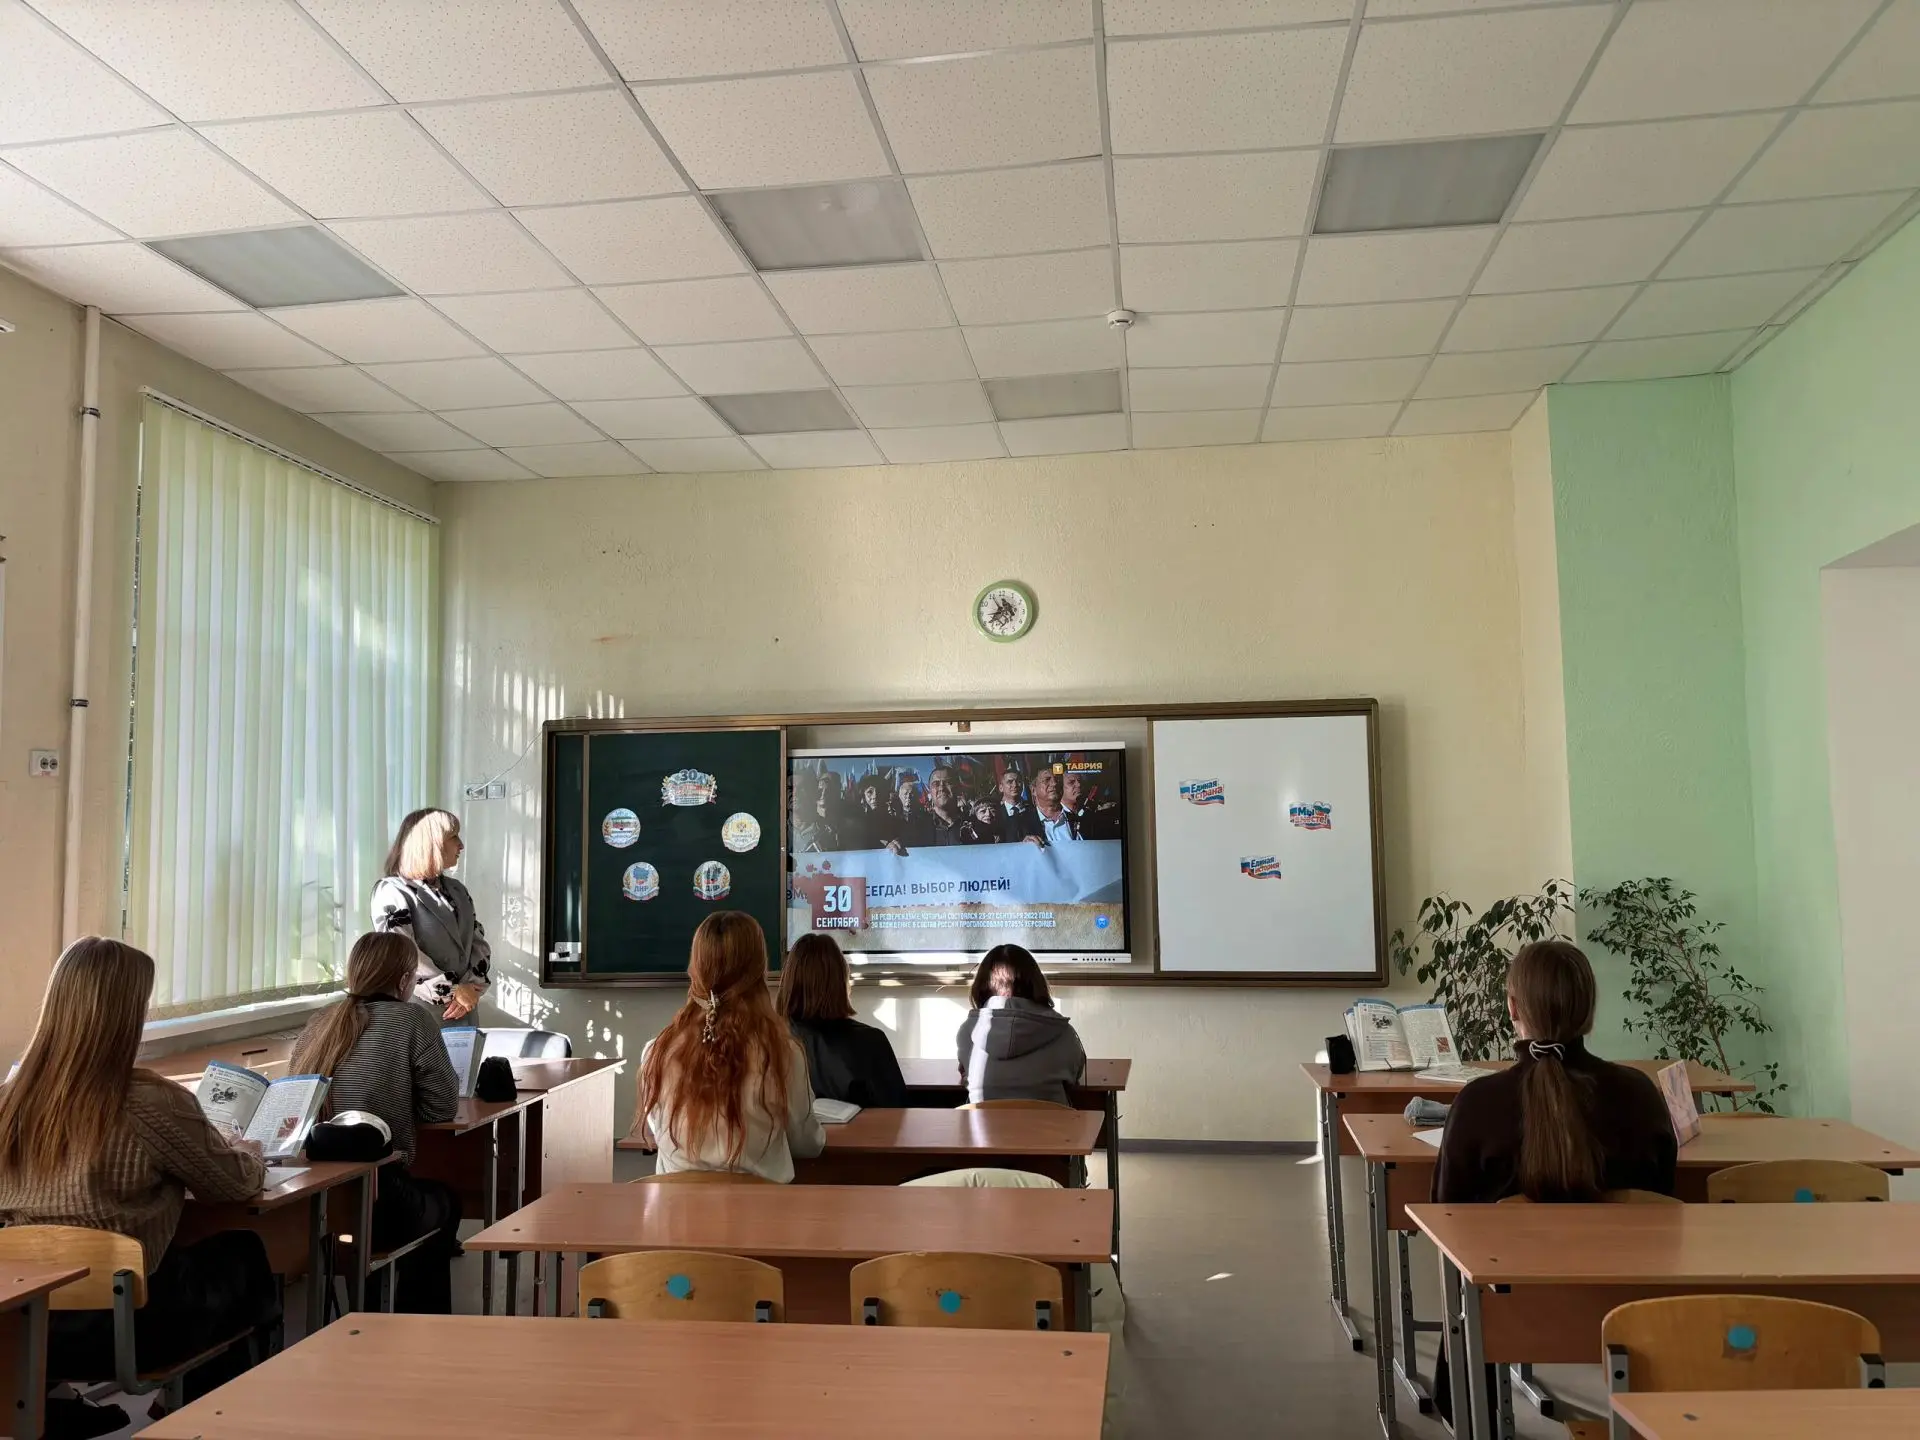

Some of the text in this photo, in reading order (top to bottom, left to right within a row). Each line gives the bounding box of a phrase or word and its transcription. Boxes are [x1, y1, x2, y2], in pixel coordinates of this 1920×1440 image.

[1066, 762, 1103, 770] ТАВРИЯ
[680, 770, 698, 781] 30
[1191, 780, 1218, 793] Единая
[1298, 807, 1314, 816] Мы
[1251, 856, 1274, 868] Единая
[911, 882, 955, 894] ВЫБОР
[958, 877, 1010, 893] ЛЮДЕЙ!
[823, 885, 852, 912] 30
[816, 916, 860, 928] СЕНТЯБРЯ
